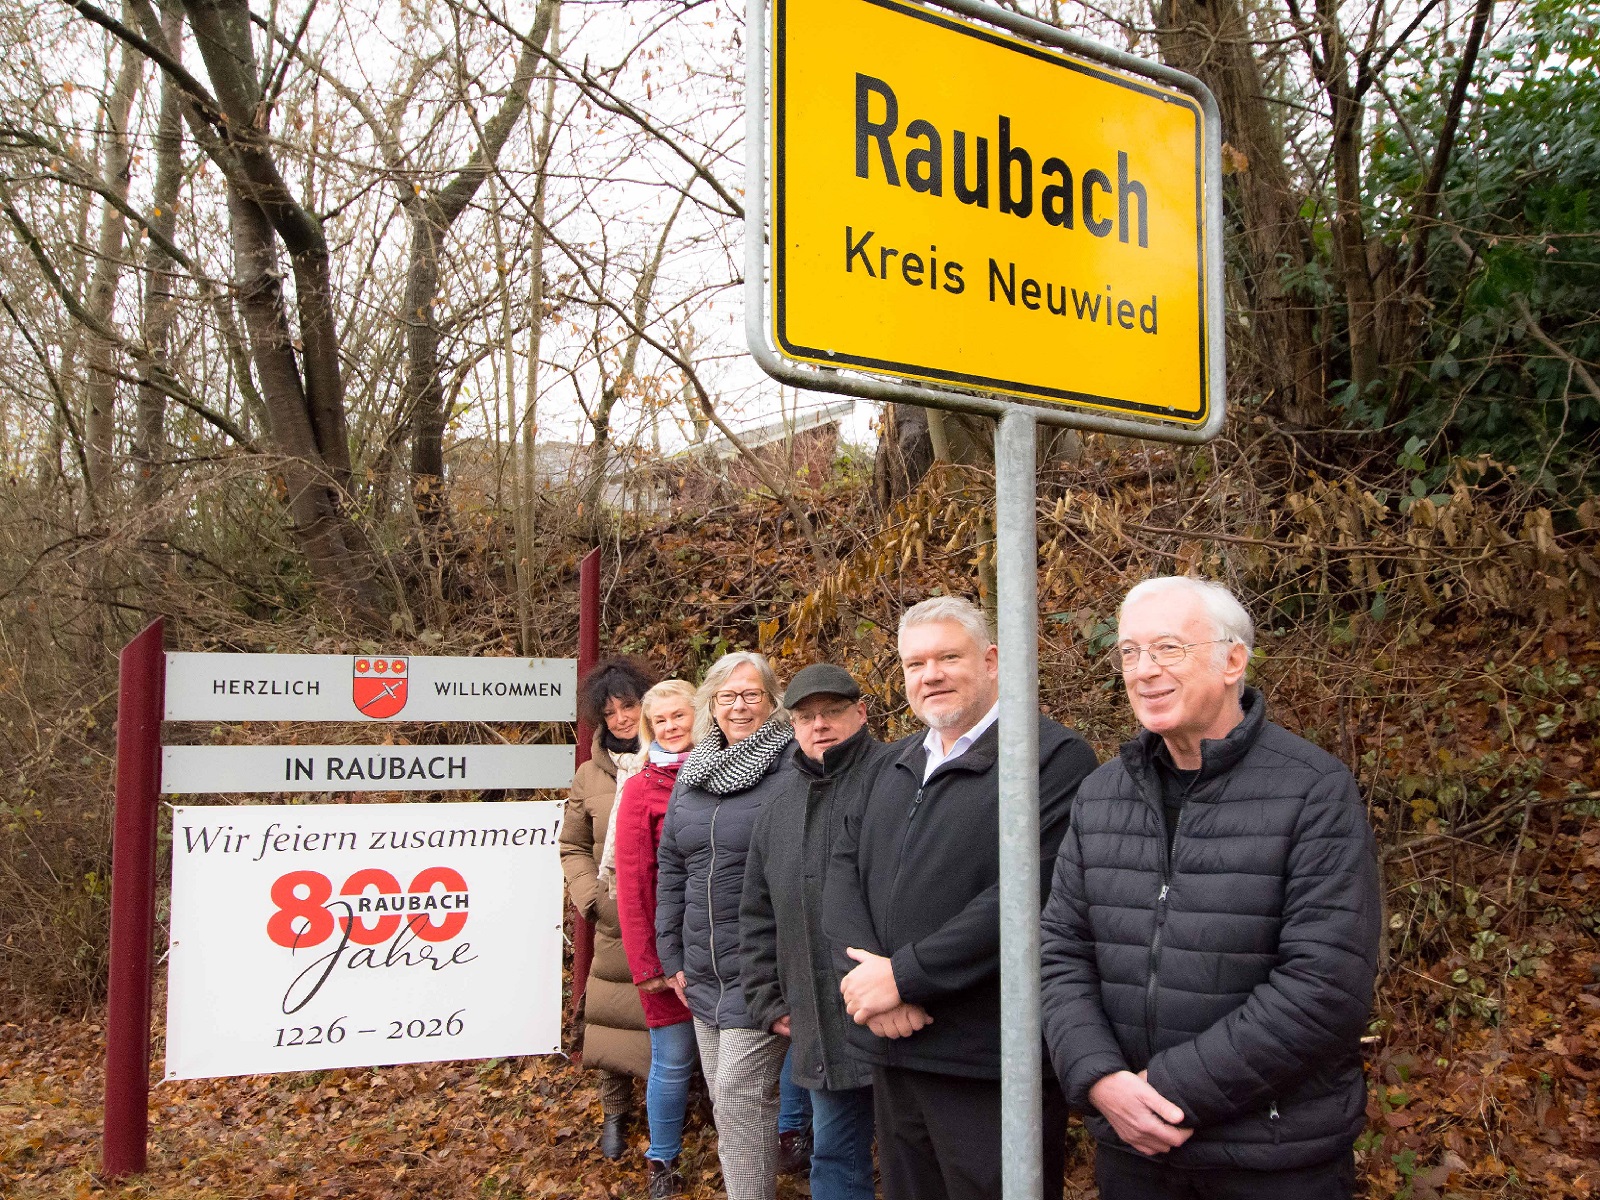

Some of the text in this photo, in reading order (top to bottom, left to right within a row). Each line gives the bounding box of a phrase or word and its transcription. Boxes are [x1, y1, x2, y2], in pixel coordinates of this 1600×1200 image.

[855, 72, 1149, 249] Raubach
[845, 226, 1158, 335] Kreis Neuwied
[213, 679, 562, 697] HERZLICH WILLKOMMEN
[285, 756, 467, 781] IN RAUBACH
[182, 820, 560, 861] Wir feiern zusammen!
[266, 866, 470, 949] 800
[358, 893, 470, 913] RAUBACH
[281, 900, 479, 1015] Jahre
[273, 1015, 347, 1048] 1226
[387, 1009, 466, 1040] 2026
